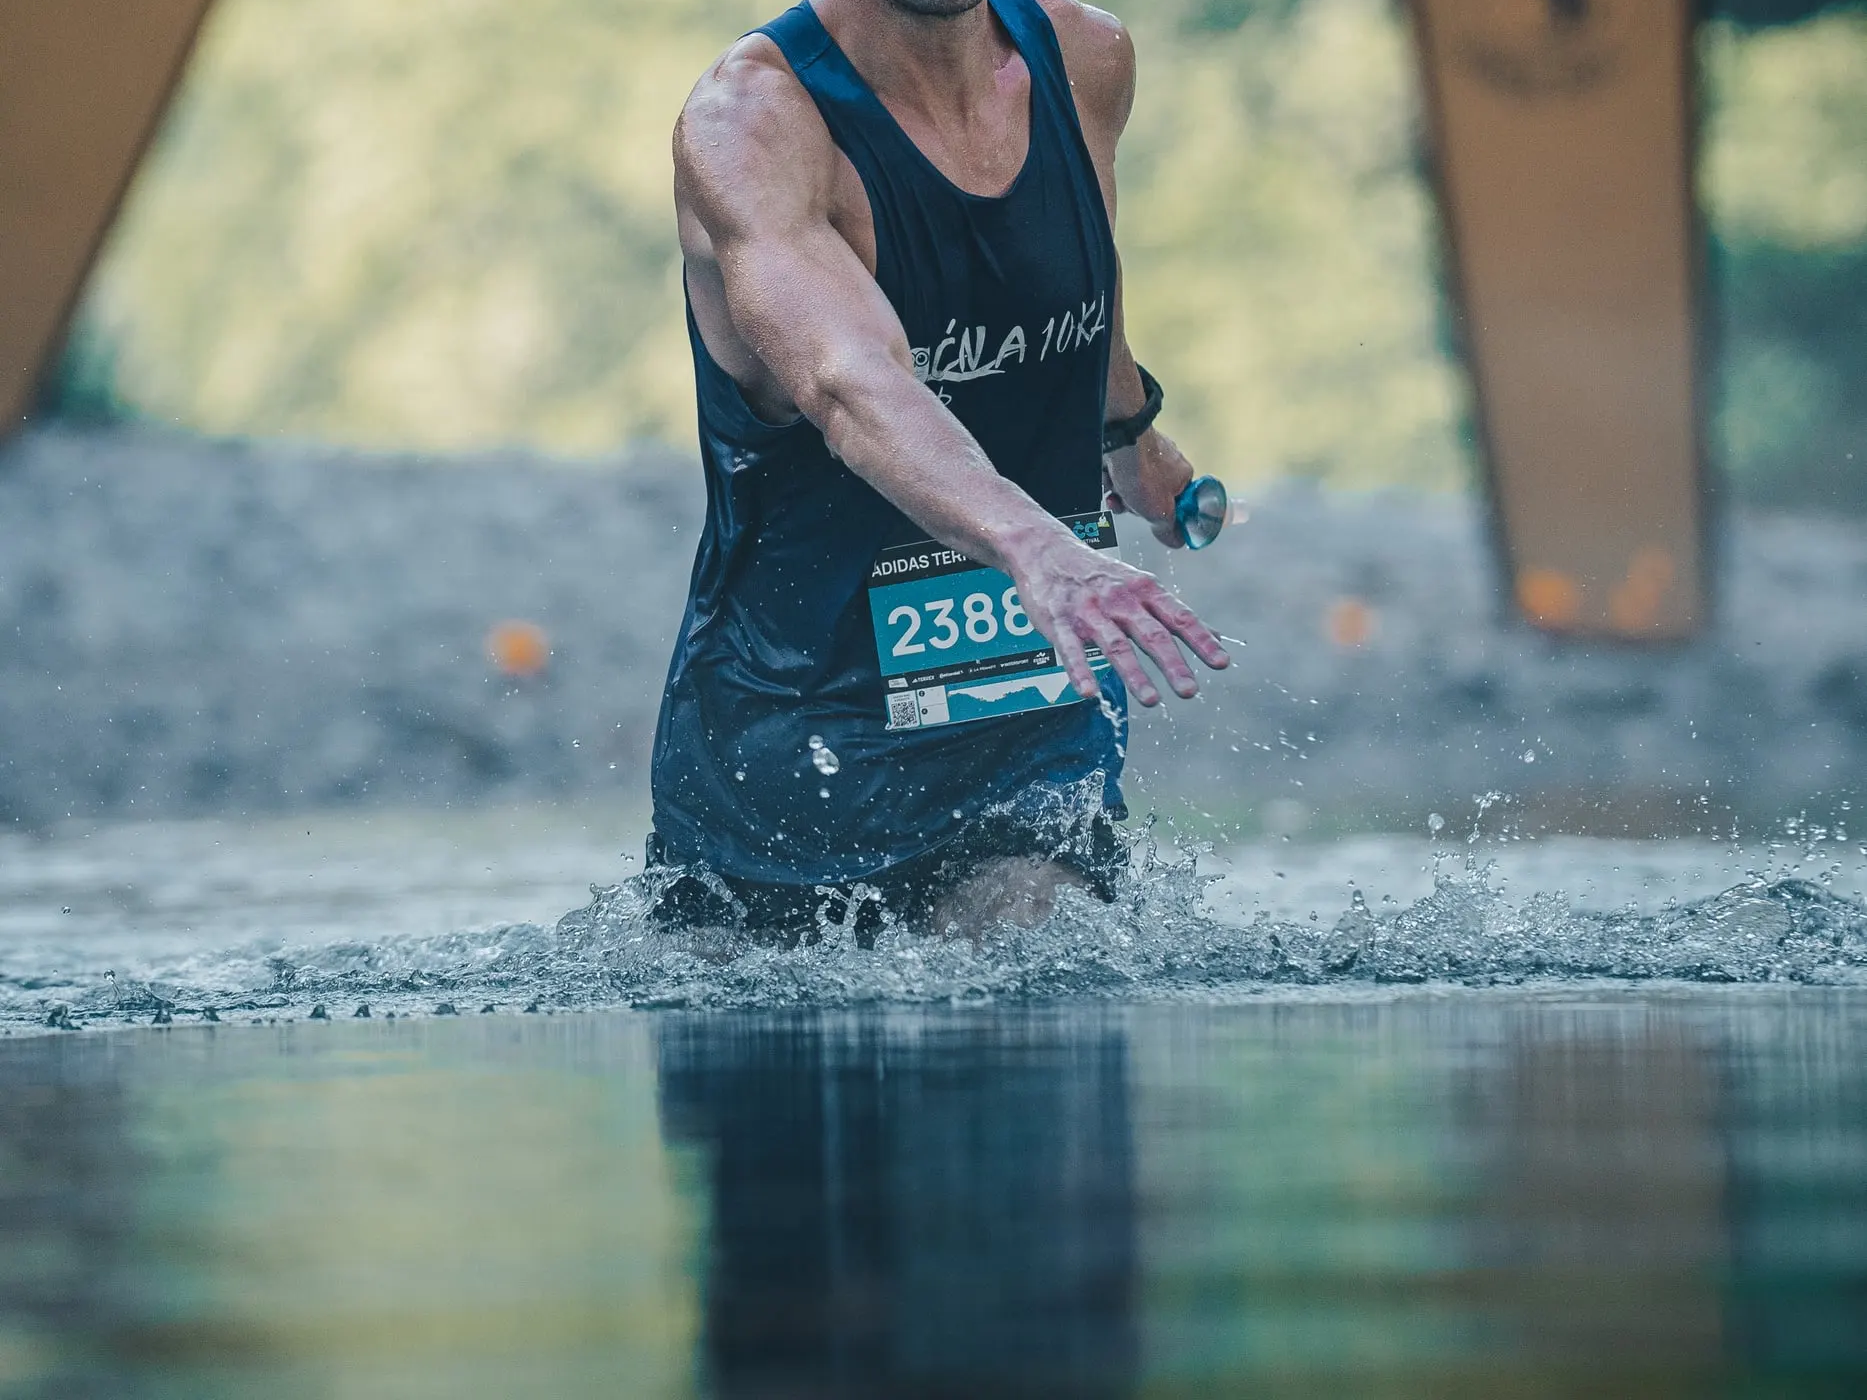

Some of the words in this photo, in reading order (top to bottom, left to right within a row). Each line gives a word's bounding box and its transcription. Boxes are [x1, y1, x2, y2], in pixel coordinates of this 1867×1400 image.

[871, 554, 930, 578] ADIDAS
[931, 550, 966, 567] TER
[887, 586, 1035, 657] 2388
